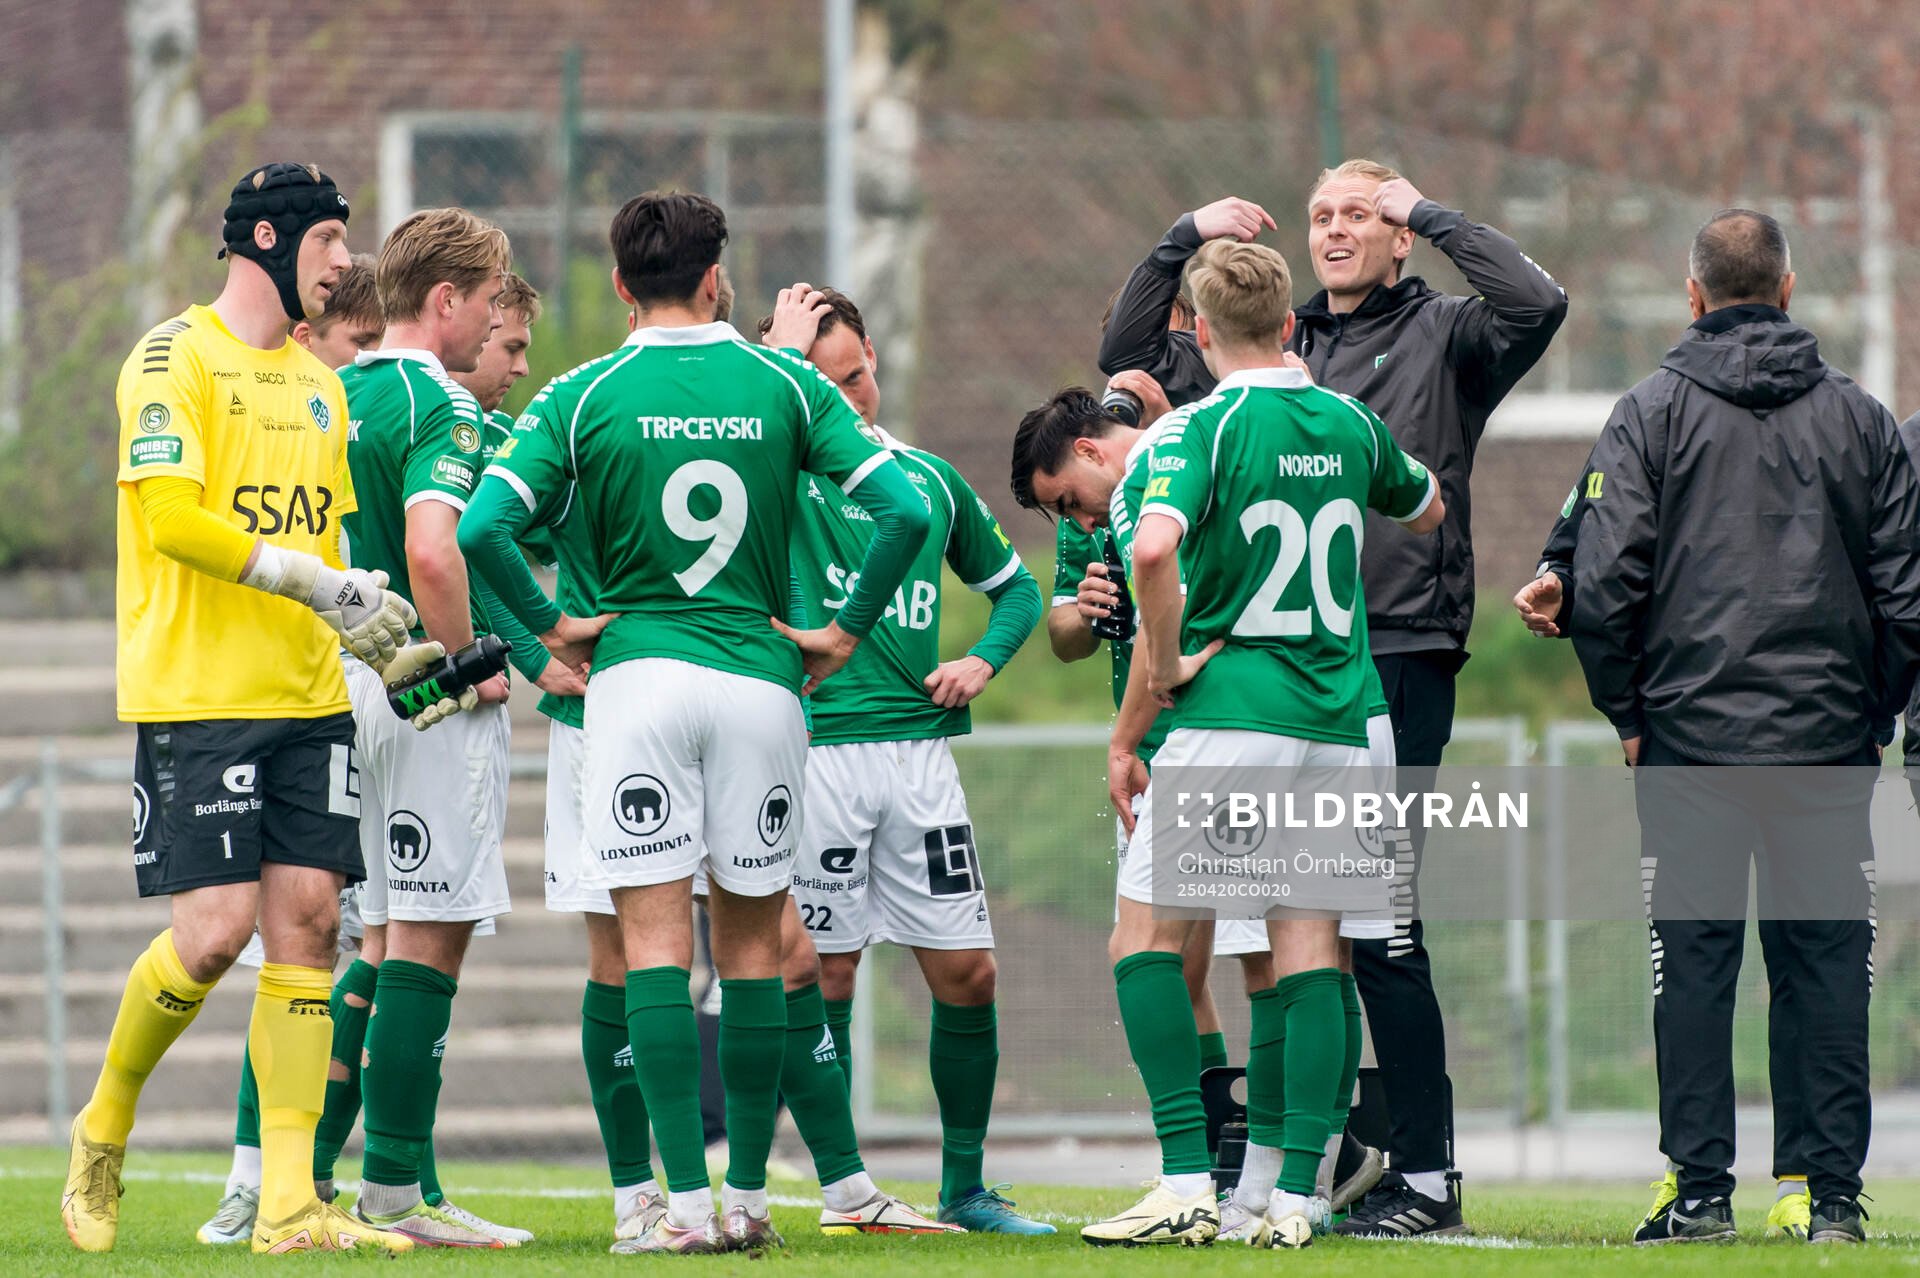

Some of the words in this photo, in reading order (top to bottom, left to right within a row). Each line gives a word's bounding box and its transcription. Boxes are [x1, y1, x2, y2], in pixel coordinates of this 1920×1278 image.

[254, 372, 287, 385] SACCI
[229, 408, 247, 416] SELECT
[637, 416, 763, 441] TRPCEVSKI
[132, 440, 180, 456] UNIBET
[437, 461, 474, 484] UNIBE
[1278, 454, 1343, 477] NORDH
[232, 485, 333, 536] SSAB
[661, 459, 749, 598] 9
[1231, 497, 1364, 637] 20
[334, 579, 354, 606] SELECT
[398, 678, 450, 715] XXL
[195, 799, 249, 816] Borlänge
[220, 830, 233, 859] 1
[601, 833, 692, 861] LOXODONTA
[733, 848, 792, 869] LOXODONTA
[388, 879, 450, 893] XODONTA
[793, 875, 844, 893] Borlänge
[847, 876, 867, 891] Energ
[801, 903, 832, 931] 22
